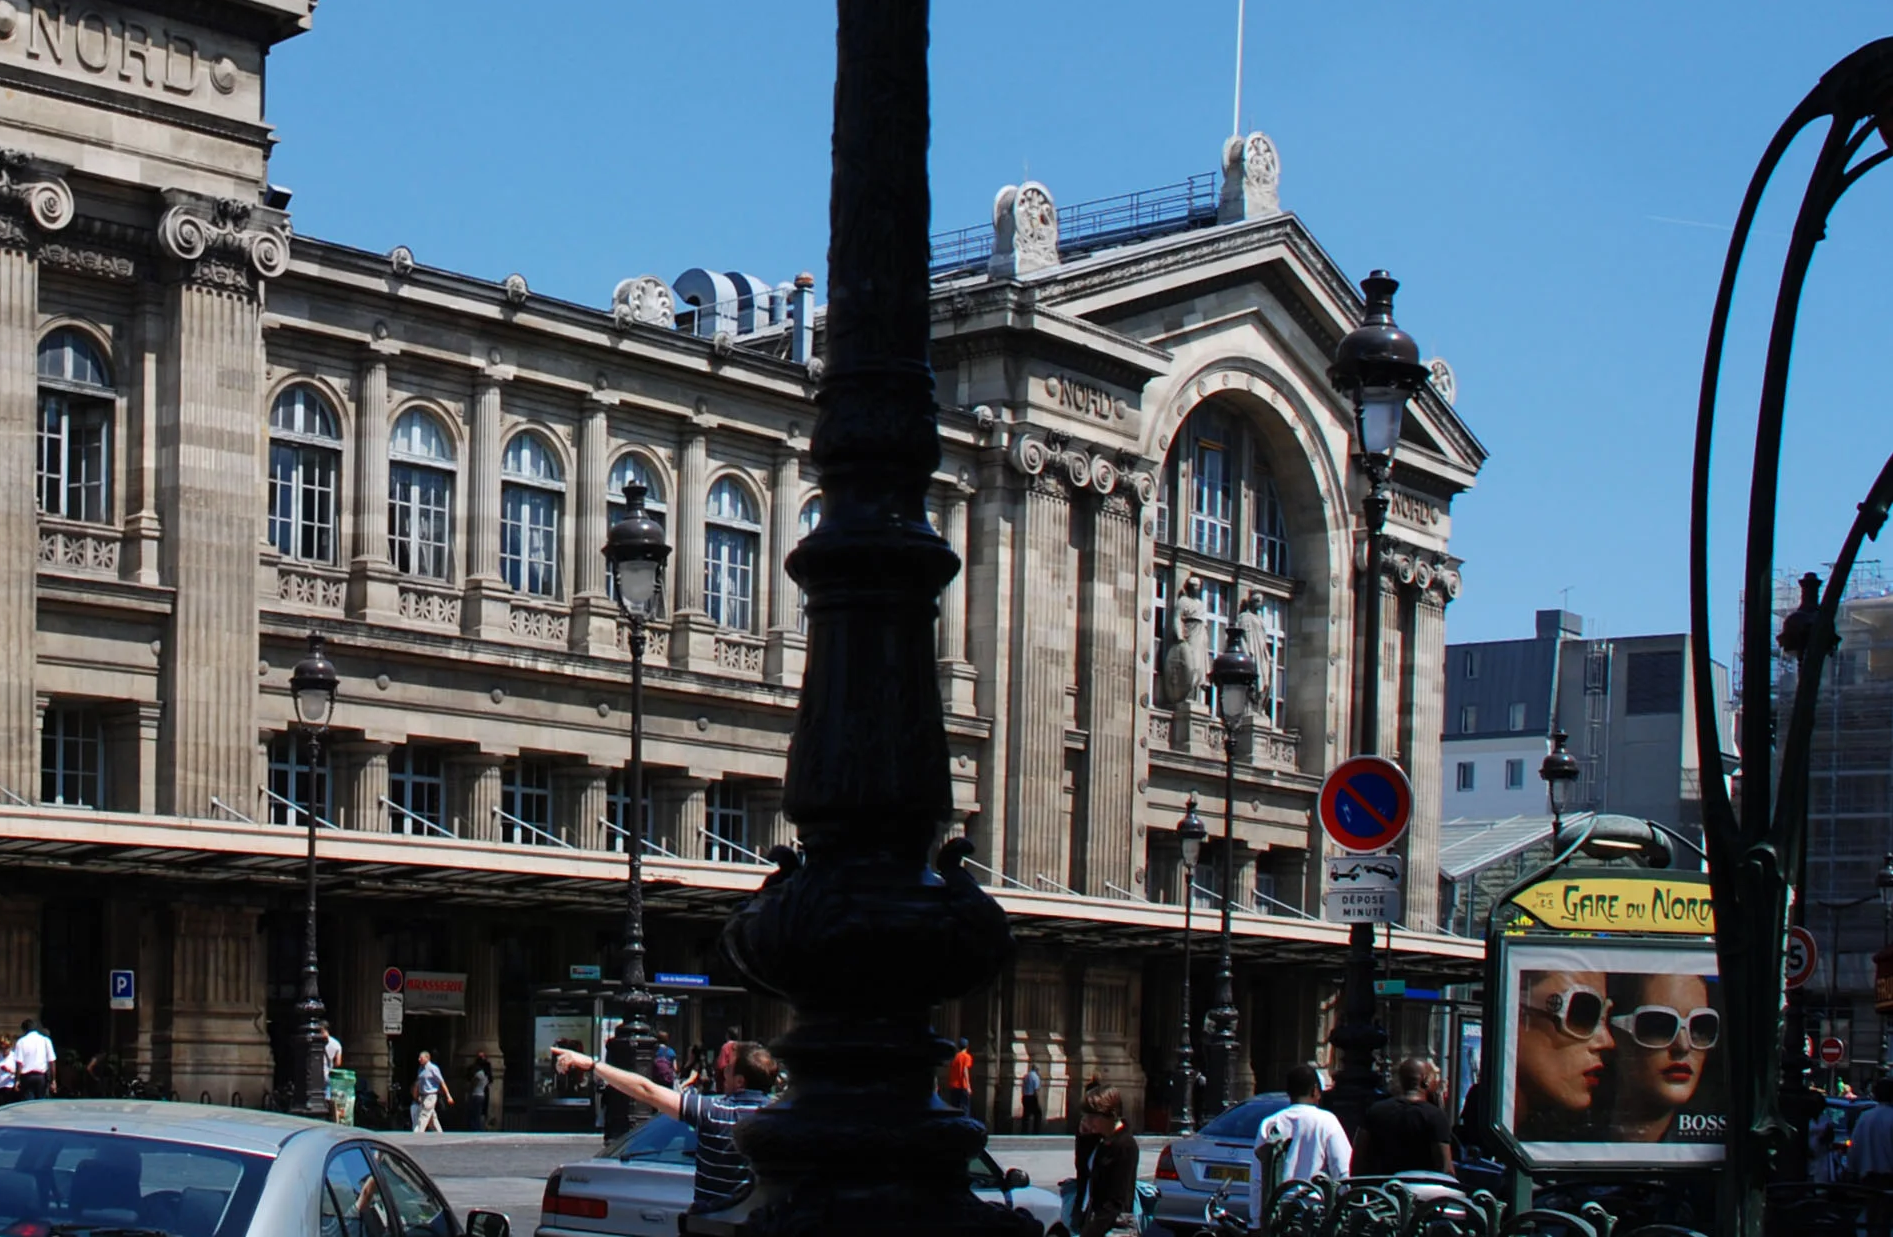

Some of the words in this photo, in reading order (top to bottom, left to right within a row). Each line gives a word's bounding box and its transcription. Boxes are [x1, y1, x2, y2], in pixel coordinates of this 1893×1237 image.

[1058, 374, 1114, 421] NORD
[1392, 491, 1431, 525] NORD
[1342, 894, 1385, 904] DÉPOSE
[1343, 908, 1385, 916] MINUTE
[117, 976, 127, 994] P
[407, 978, 464, 992] BRASSERIE
[1678, 1114, 1728, 1131] BOSS
